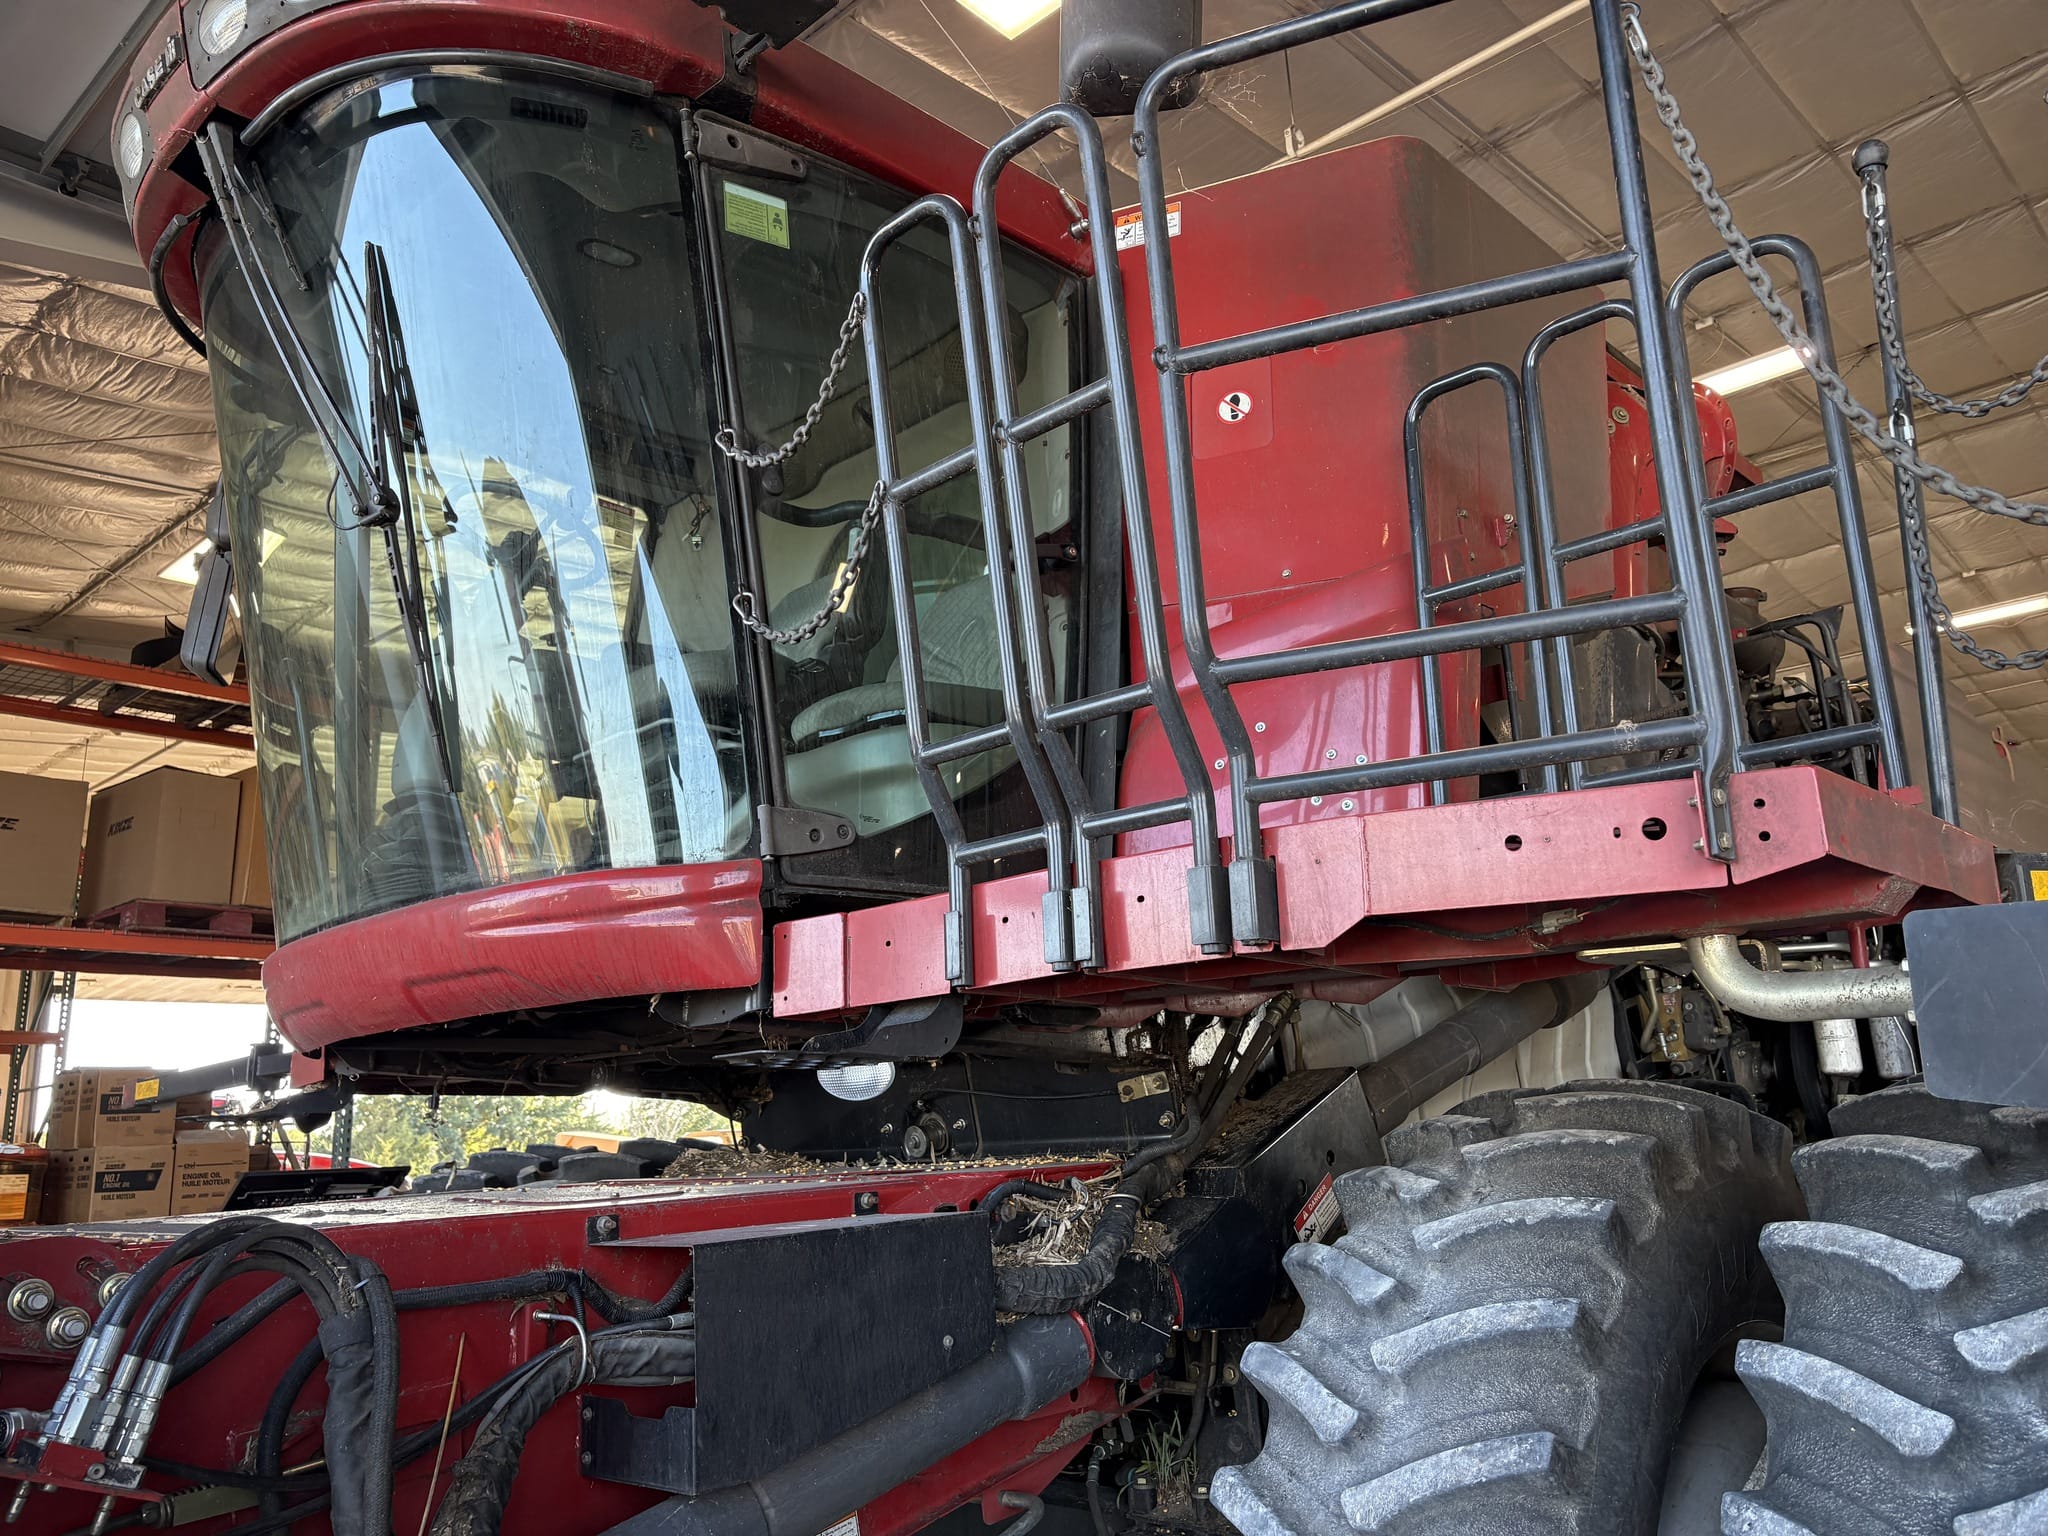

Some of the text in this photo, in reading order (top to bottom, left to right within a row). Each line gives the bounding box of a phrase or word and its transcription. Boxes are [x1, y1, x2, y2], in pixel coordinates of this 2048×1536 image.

[182, 1171, 222, 1180] ENGINE OIL
[181, 1179, 231, 1188] HUILE MOTEUR
[1308, 1184, 1327, 1211] DANGER
